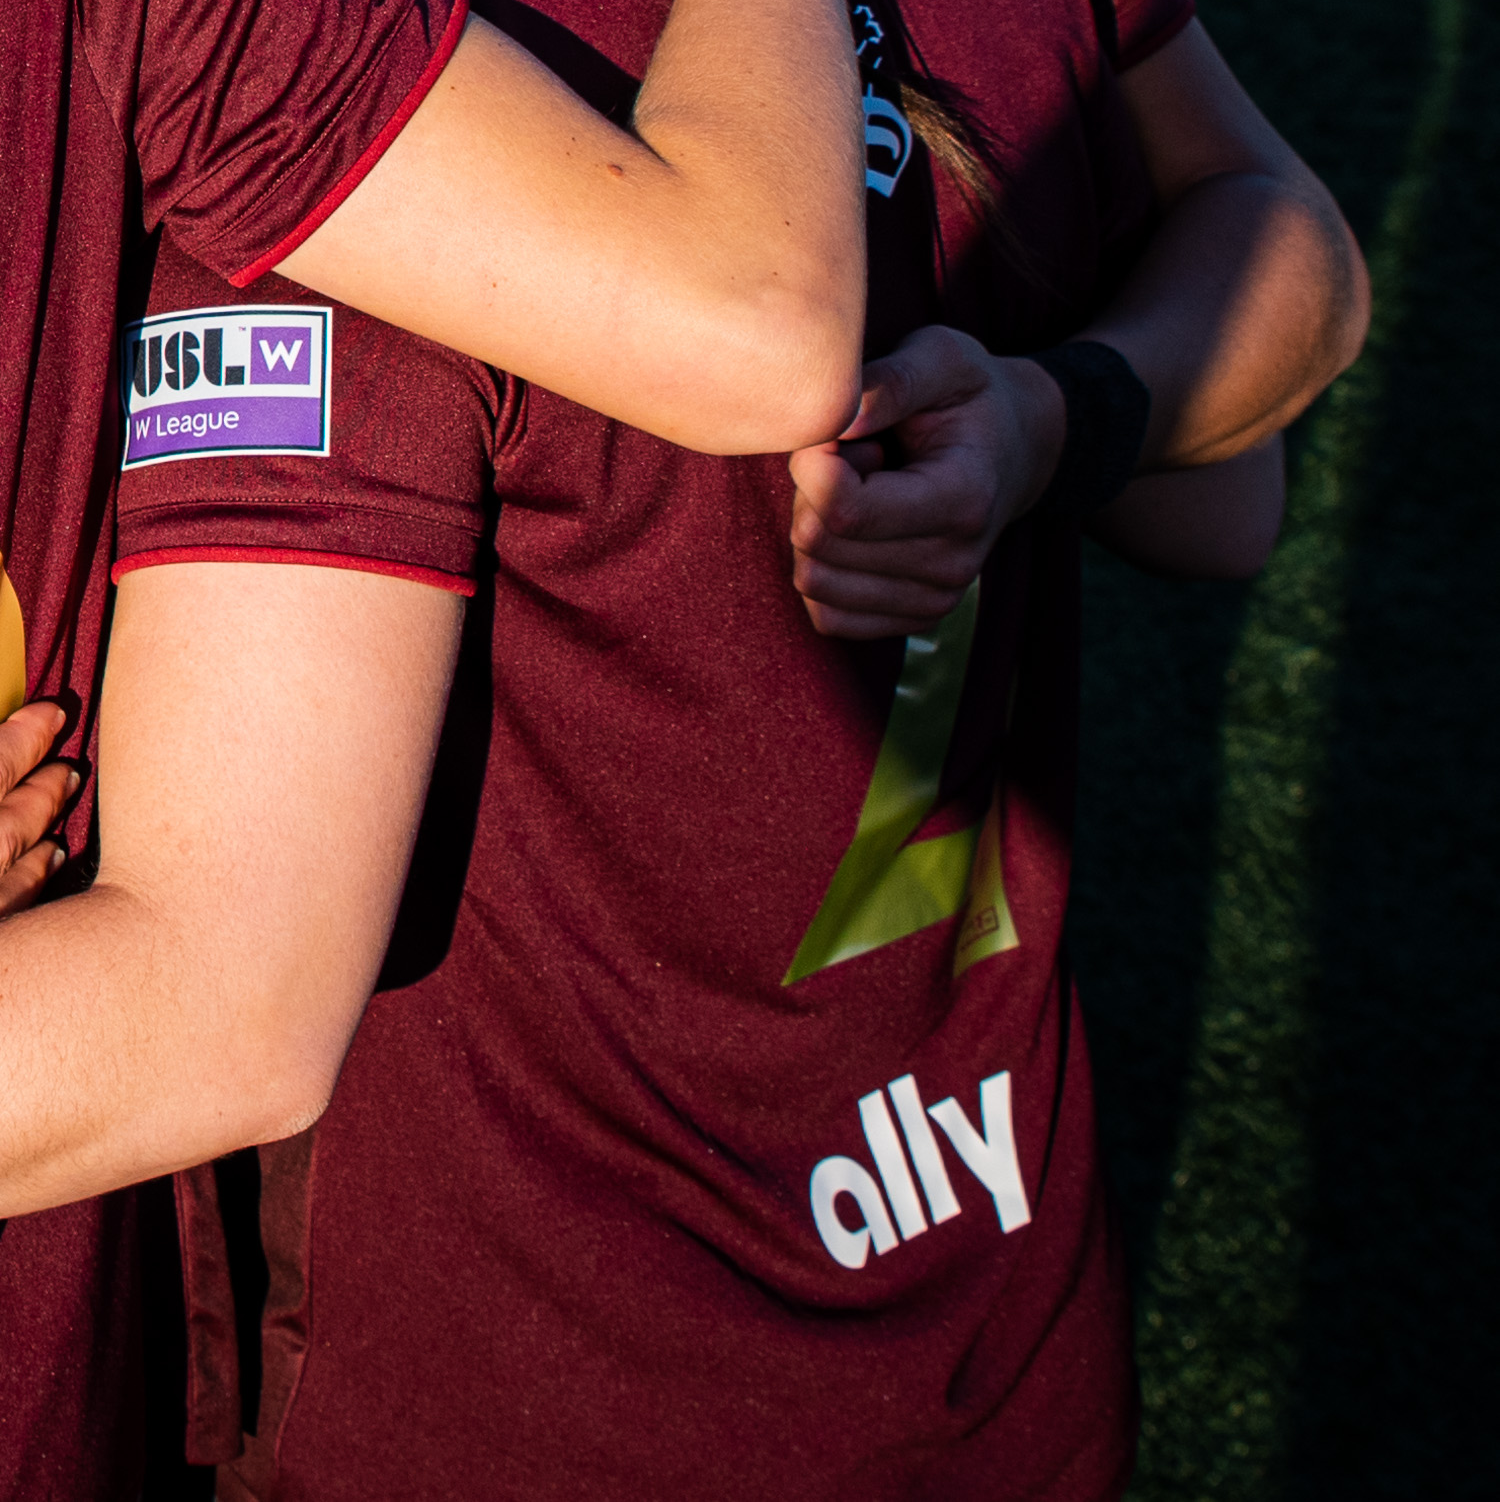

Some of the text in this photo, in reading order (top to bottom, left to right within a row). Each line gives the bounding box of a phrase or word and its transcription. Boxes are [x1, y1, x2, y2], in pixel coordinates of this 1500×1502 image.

[132, 327, 245, 398] USL
[259, 339, 303, 372] W
[135, 410, 240, 440] W League
[810, 1069, 1032, 1270] ally
